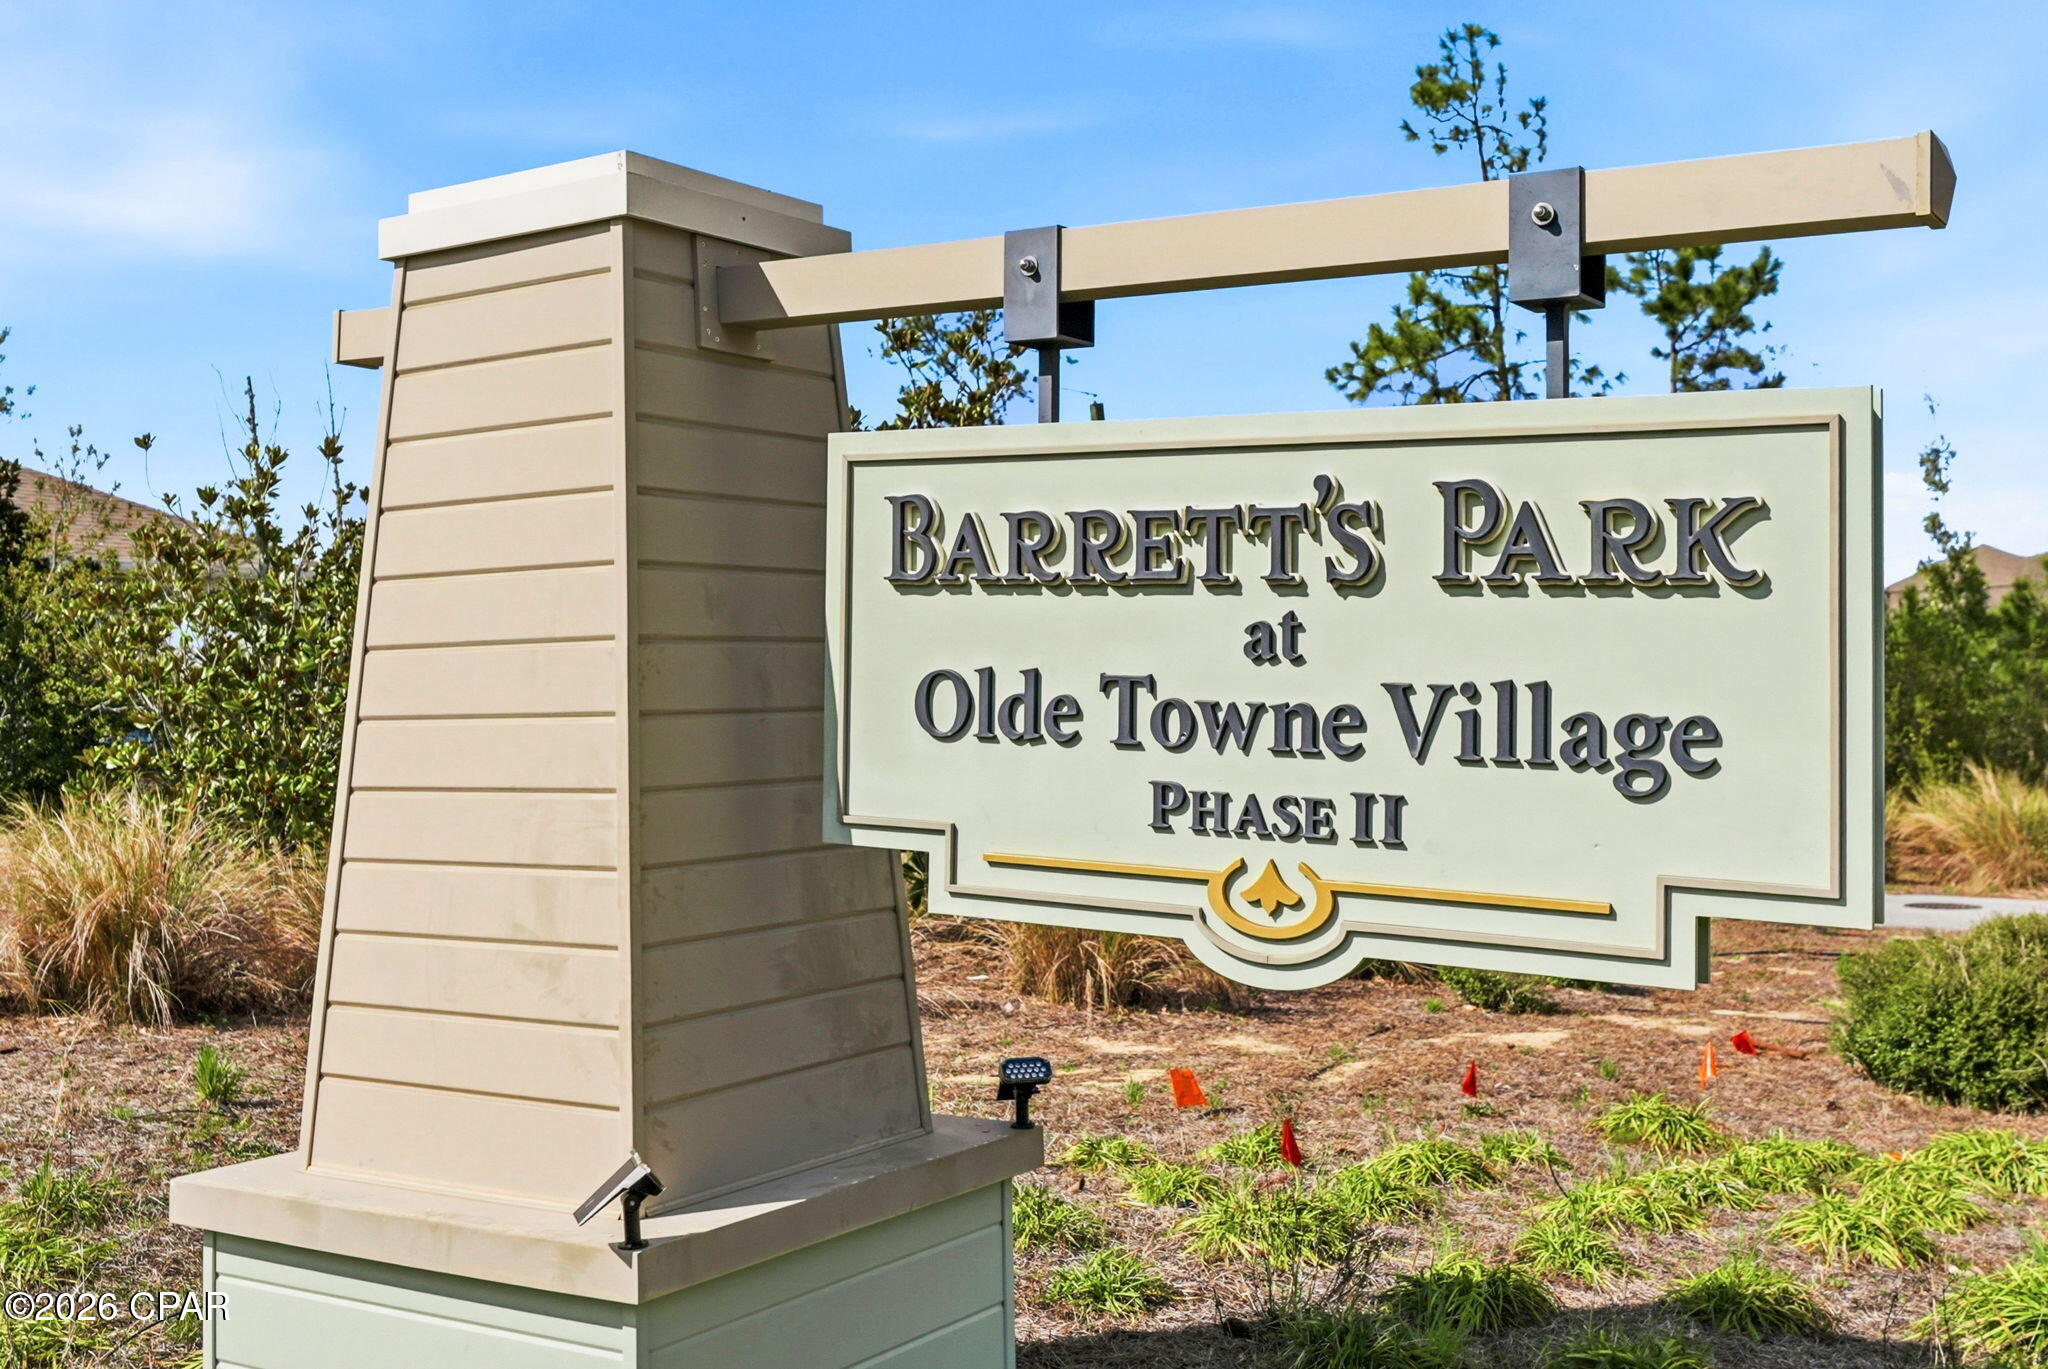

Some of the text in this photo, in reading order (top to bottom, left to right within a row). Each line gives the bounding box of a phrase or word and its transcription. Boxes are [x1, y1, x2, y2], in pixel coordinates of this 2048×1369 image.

[884, 474, 1767, 588] BARRETT'S PARK
[1243, 610, 1304, 664] at
[914, 667, 1720, 800] Olde Towne Village
[1147, 780, 1406, 847] PHASE II
